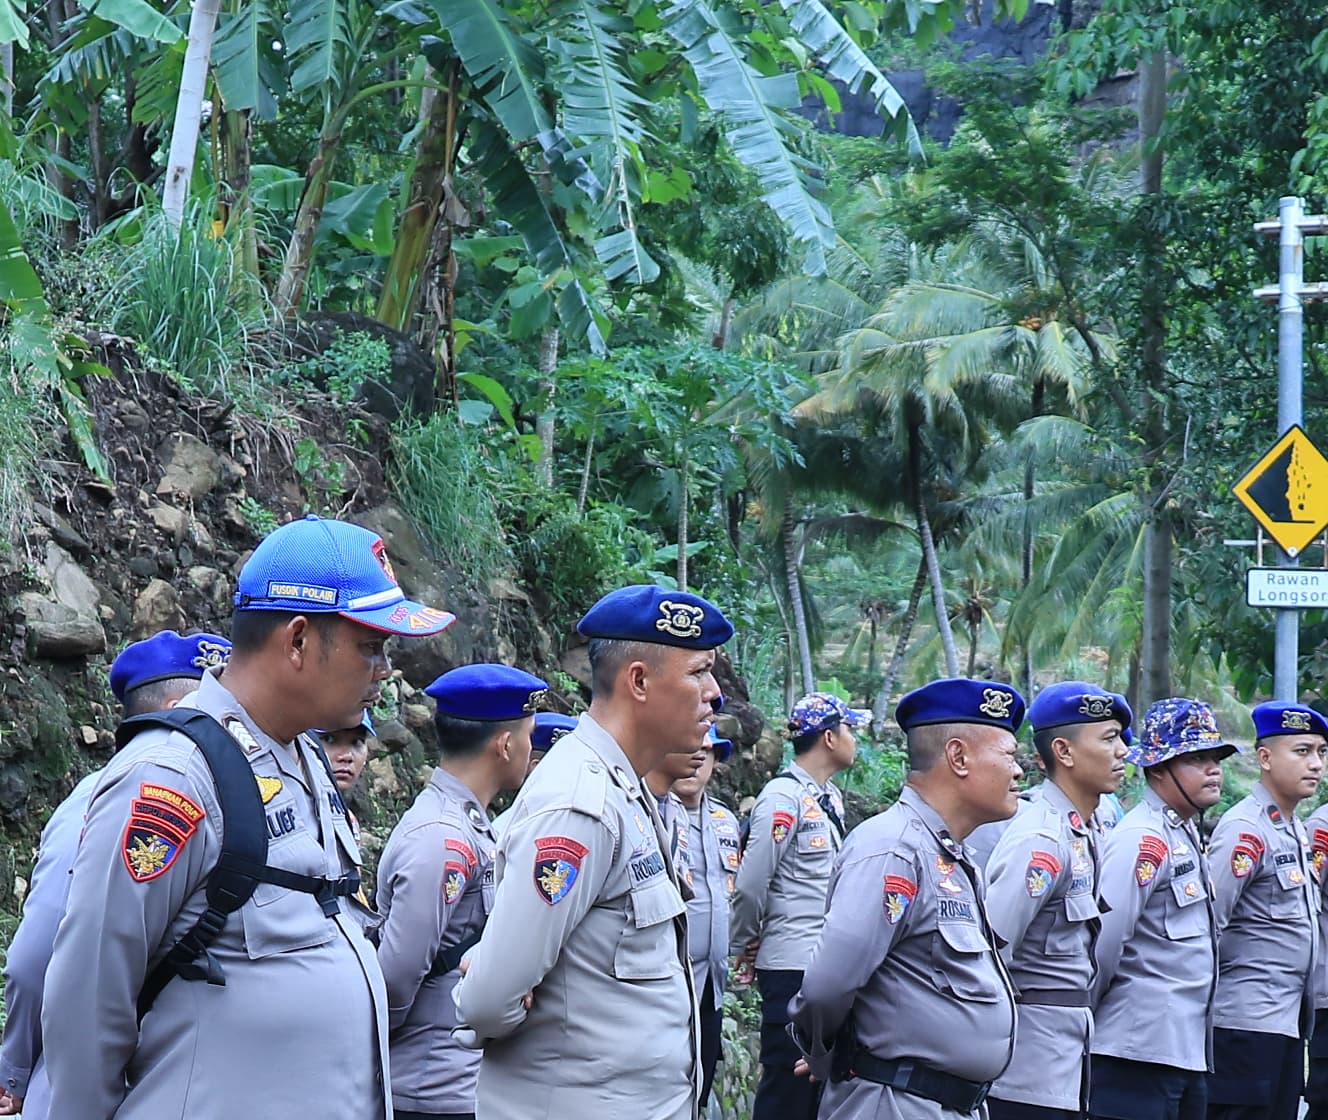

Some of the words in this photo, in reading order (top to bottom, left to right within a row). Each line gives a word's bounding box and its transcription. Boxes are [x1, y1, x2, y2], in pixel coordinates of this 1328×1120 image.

[1266, 573, 1319, 585] Rawan
[302, 587, 334, 601] POLAIR
[1258, 589, 1328, 604] Longsor
[409, 607, 450, 630] AIR
[266, 807, 296, 840] LIEF
